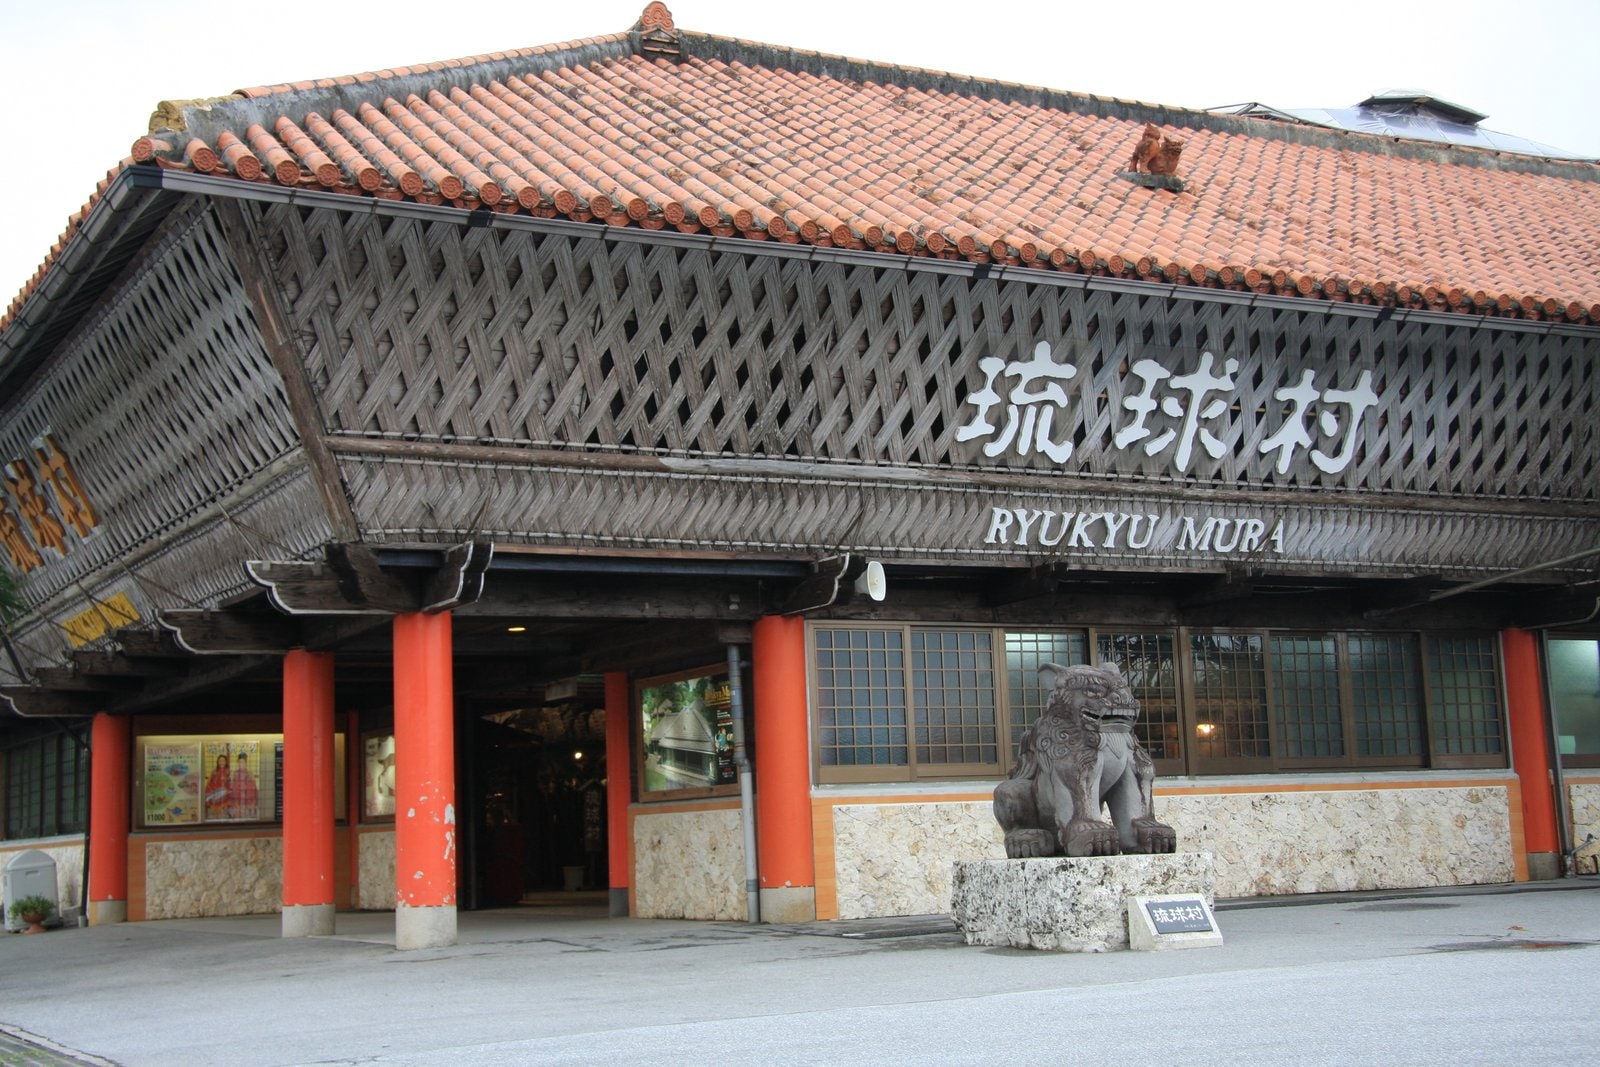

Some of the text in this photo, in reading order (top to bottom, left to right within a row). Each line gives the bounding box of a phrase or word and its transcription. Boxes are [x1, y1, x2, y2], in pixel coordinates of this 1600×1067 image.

[955, 340, 1378, 475] 琉球村
[983, 507, 1285, 553] RYUKYU MURA
[1152, 905, 1204, 923] 琉球村
